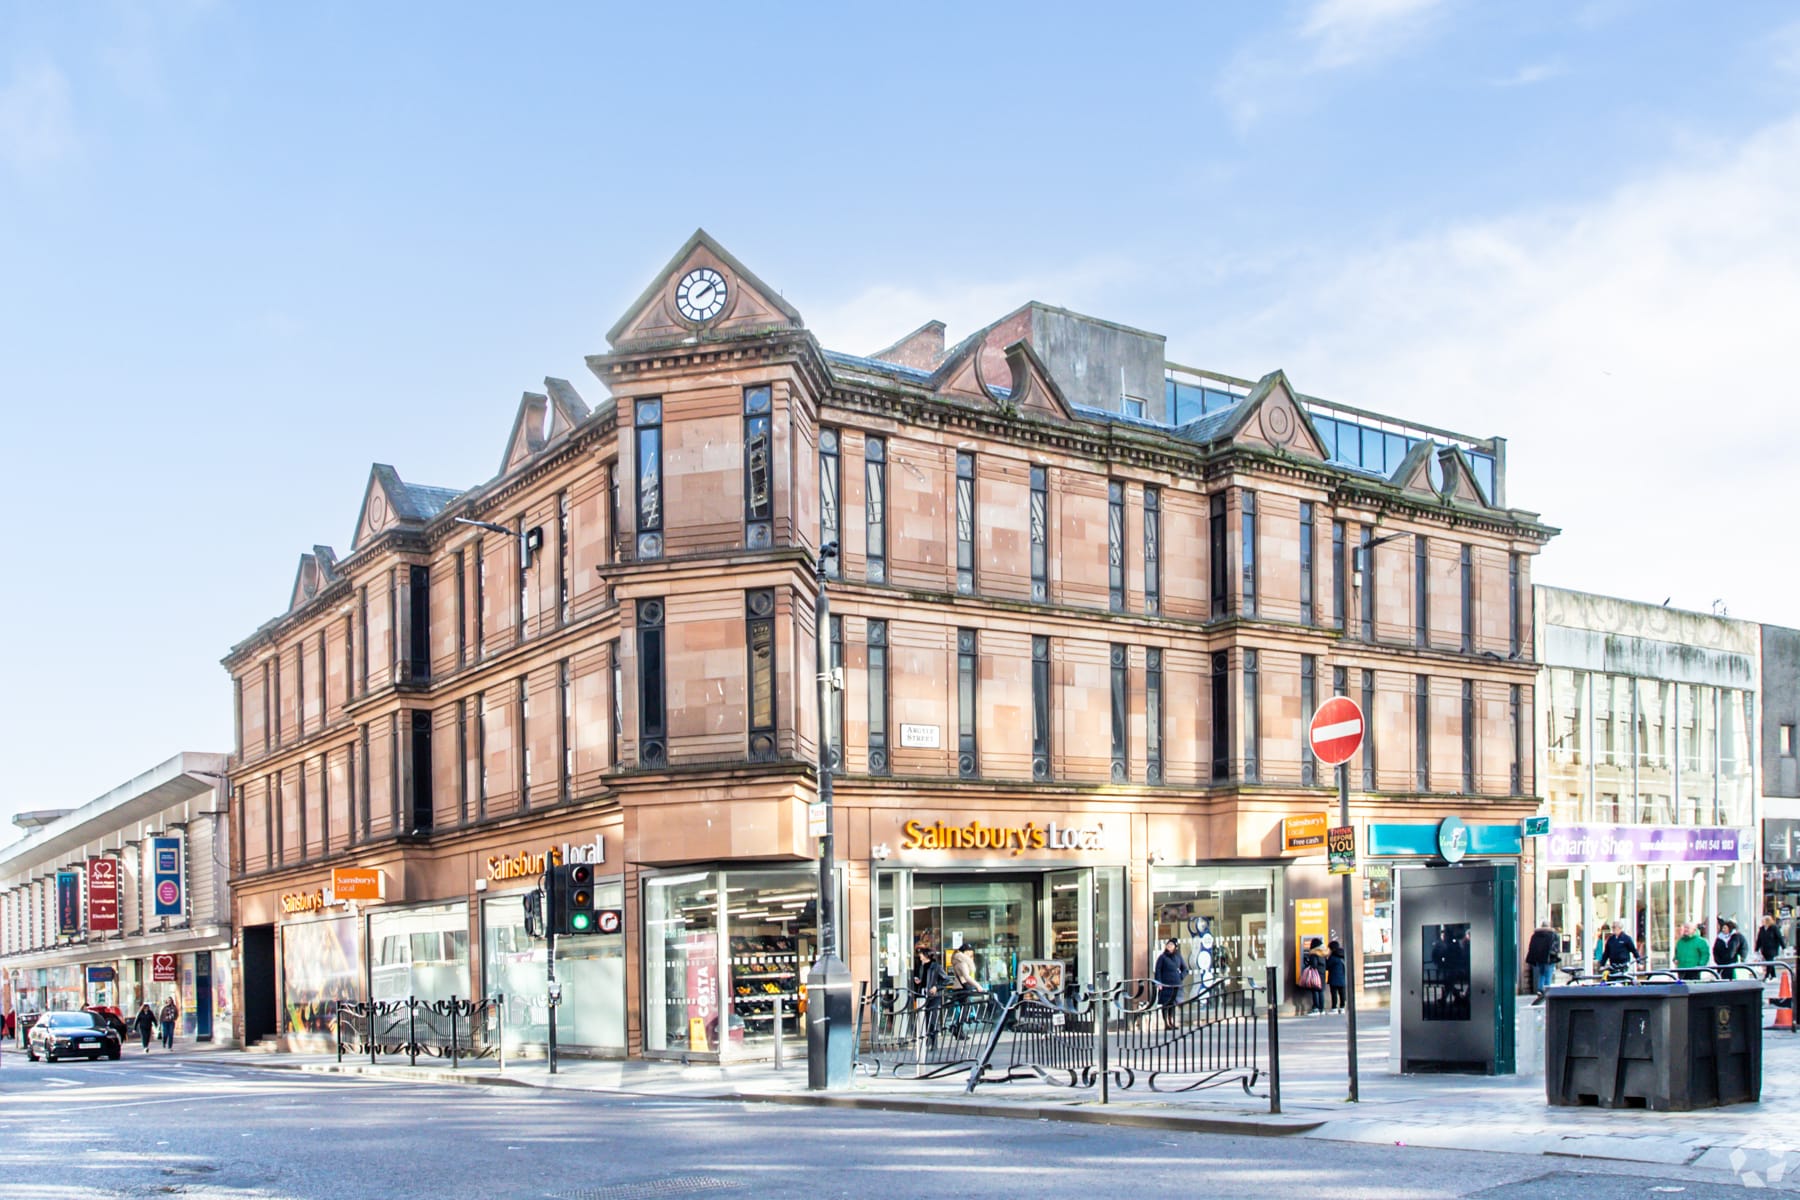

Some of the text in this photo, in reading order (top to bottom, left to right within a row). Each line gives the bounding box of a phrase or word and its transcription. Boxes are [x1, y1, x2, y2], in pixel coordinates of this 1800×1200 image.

[1287, 817, 1325, 827] Sainsbury's
[902, 819, 1104, 856] Sainsbury's Local
[1330, 827, 1353, 836] THINK
[1293, 838, 1305, 846] Free
[1329, 834, 1353, 842] BEFORE
[563, 834, 605, 865] Local
[1329, 840, 1354, 852] YOU
[1551, 835, 1598, 858] Charity
[1600, 835, 1634, 857] Shop
[337, 877, 376, 885] Sainsbury's
[281, 889, 323, 914] Sainsbury's
[698, 966, 709, 1017] COSTA
